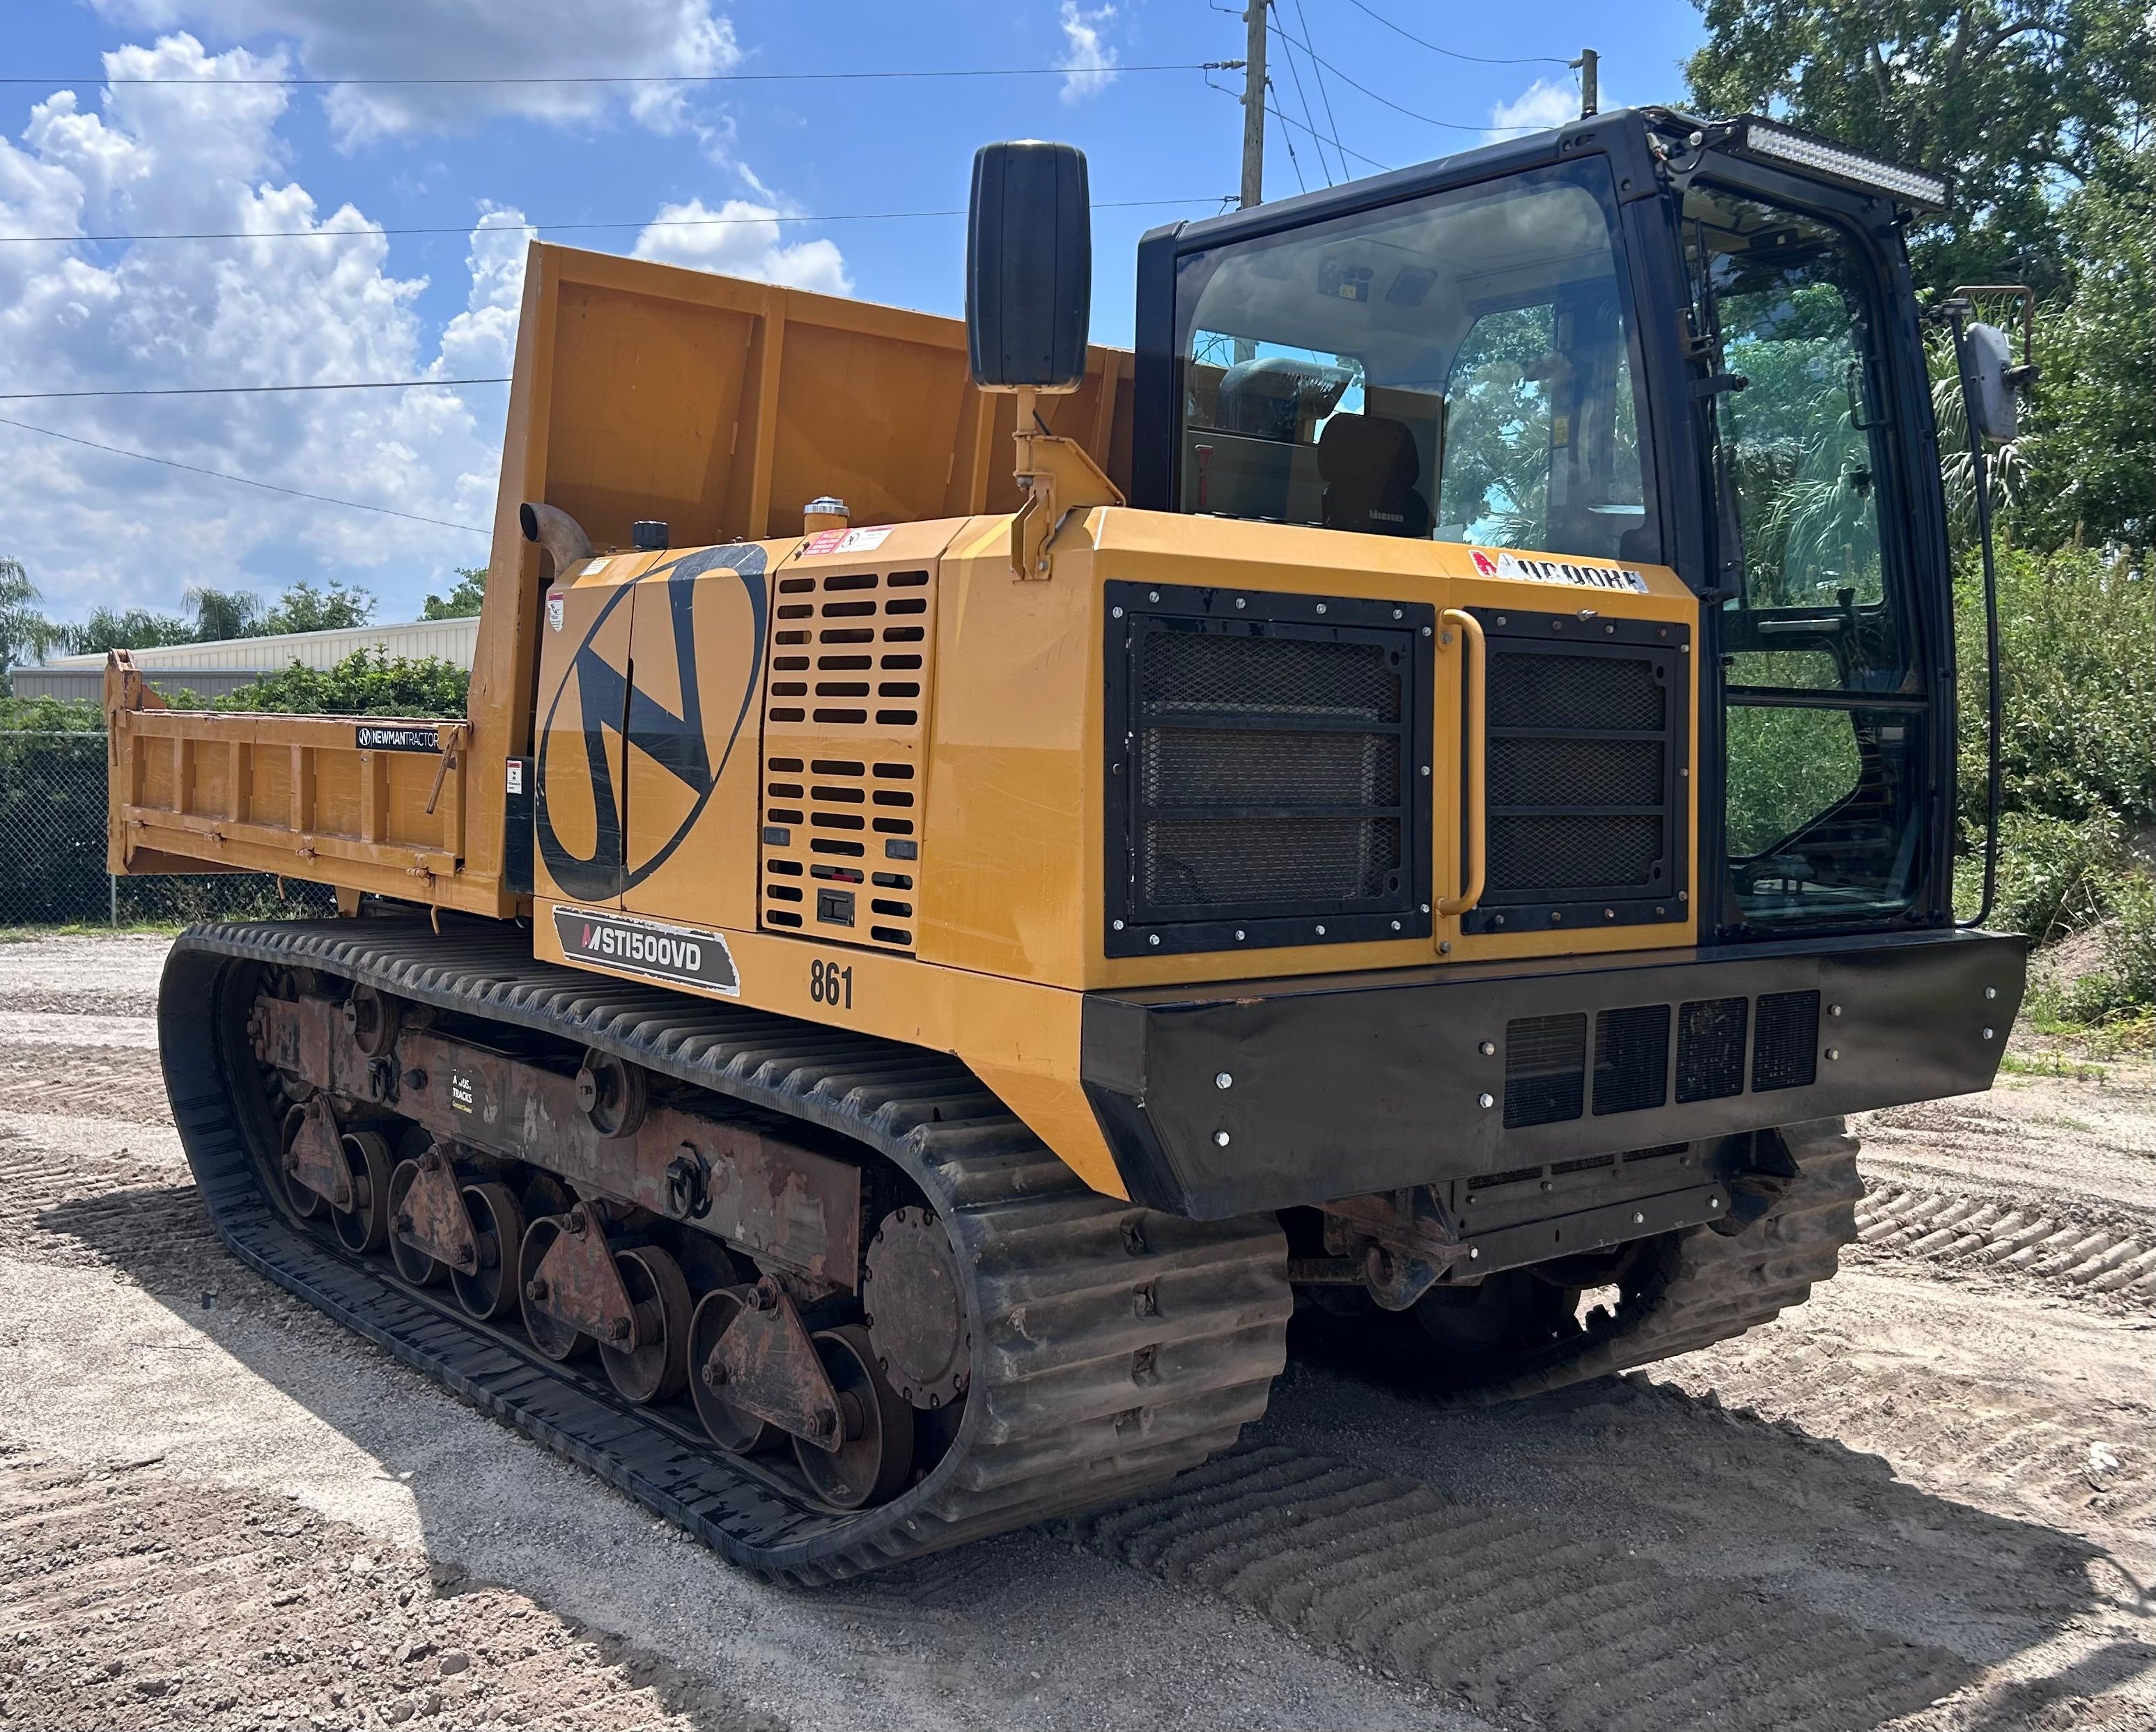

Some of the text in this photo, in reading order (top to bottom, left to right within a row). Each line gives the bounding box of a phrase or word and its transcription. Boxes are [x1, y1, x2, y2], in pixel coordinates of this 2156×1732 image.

[581, 923, 701, 972] MST1500VD
[809, 959, 853, 1010] 861
[452, 1086, 472, 1104] TRACKS
